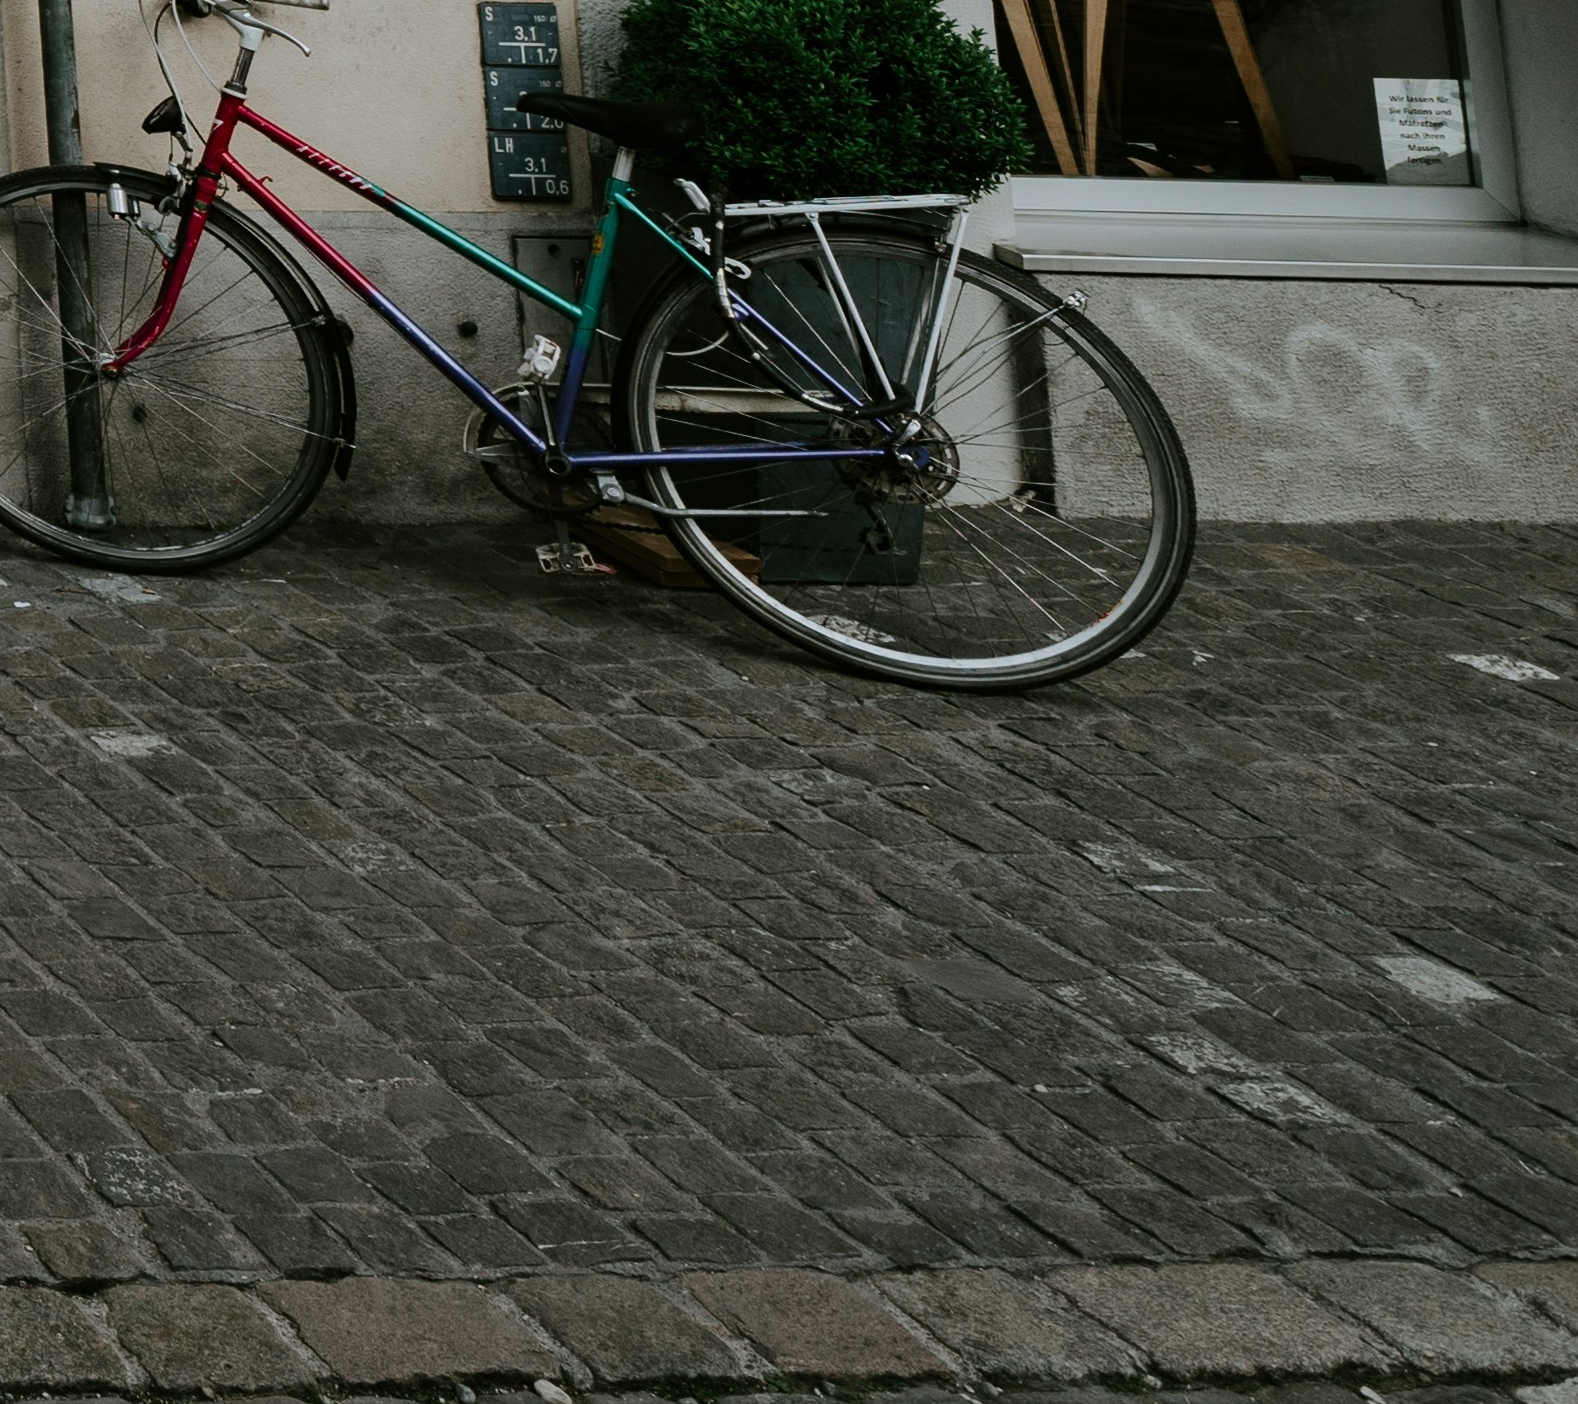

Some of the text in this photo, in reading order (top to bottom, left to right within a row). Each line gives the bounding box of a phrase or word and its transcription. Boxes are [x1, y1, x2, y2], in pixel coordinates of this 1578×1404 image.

[484, 6, 494, 22] S
[489, 70, 499, 87] S
[1406, 95, 1434, 103] lassen
[1388, 107, 1401, 115] Sie
[494, 137, 514, 153] LH
[1408, 144, 1441, 152] Massen
